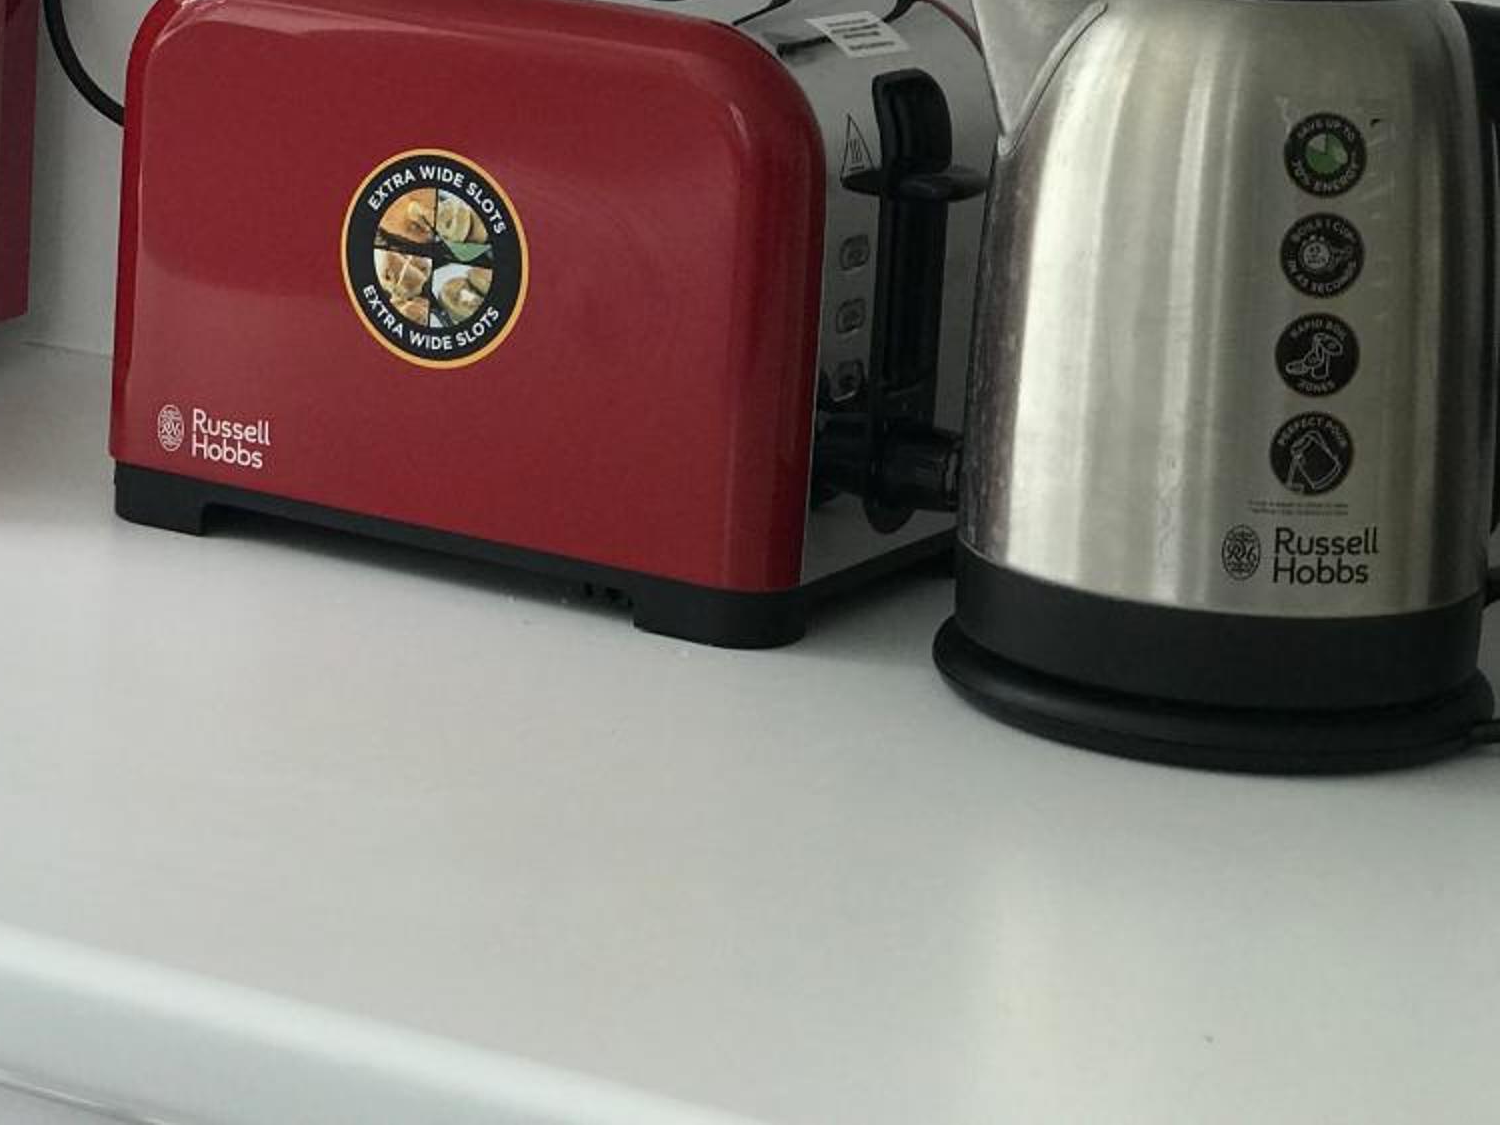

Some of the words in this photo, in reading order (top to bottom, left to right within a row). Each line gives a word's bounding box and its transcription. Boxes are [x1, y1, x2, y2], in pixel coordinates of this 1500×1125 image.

[367, 169, 417, 211] EXTRA
[419, 165, 465, 188] WIDE
[465, 182, 507, 235] SLOTS
[363, 284, 404, 338] EXTRA
[409, 330, 453, 351] WIDE
[455, 306, 500, 347] SLOTS
[192, 407, 271, 446] Russell
[191, 432, 264, 470] Hobbs
[1274, 526, 1380, 556] Russell
[1272, 556, 1370, 585] Hobbs
